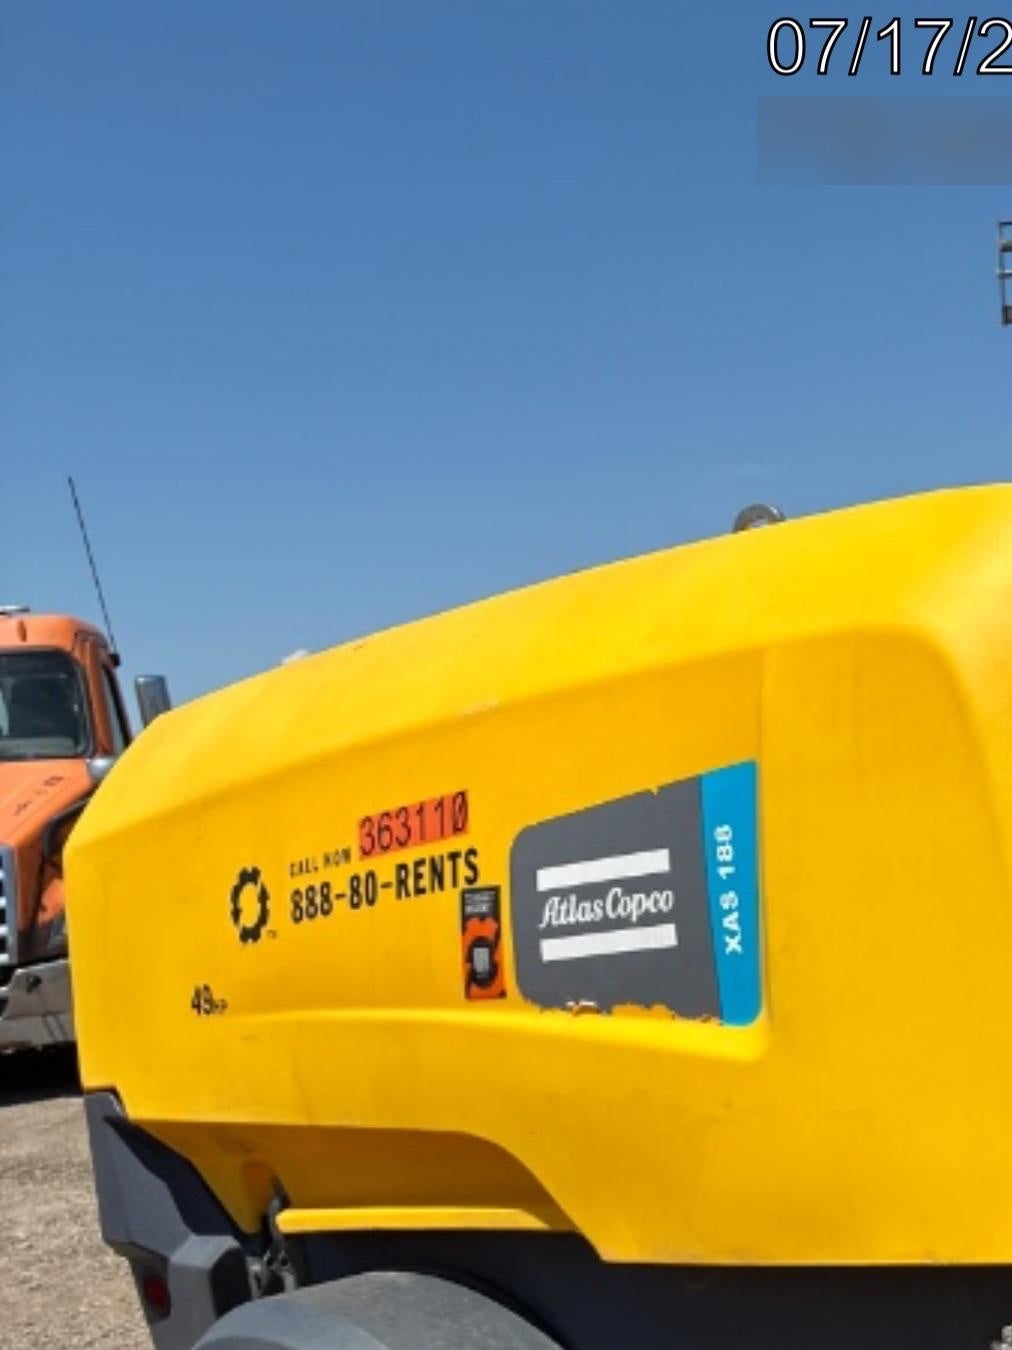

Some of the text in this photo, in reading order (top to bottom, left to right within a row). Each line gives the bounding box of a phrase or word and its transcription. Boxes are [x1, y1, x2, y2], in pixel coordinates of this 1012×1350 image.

[359, 790, 468, 856] 363110
[290, 848, 478, 924] 888-80-RENTS
[713, 824, 743, 955] XAS 188
